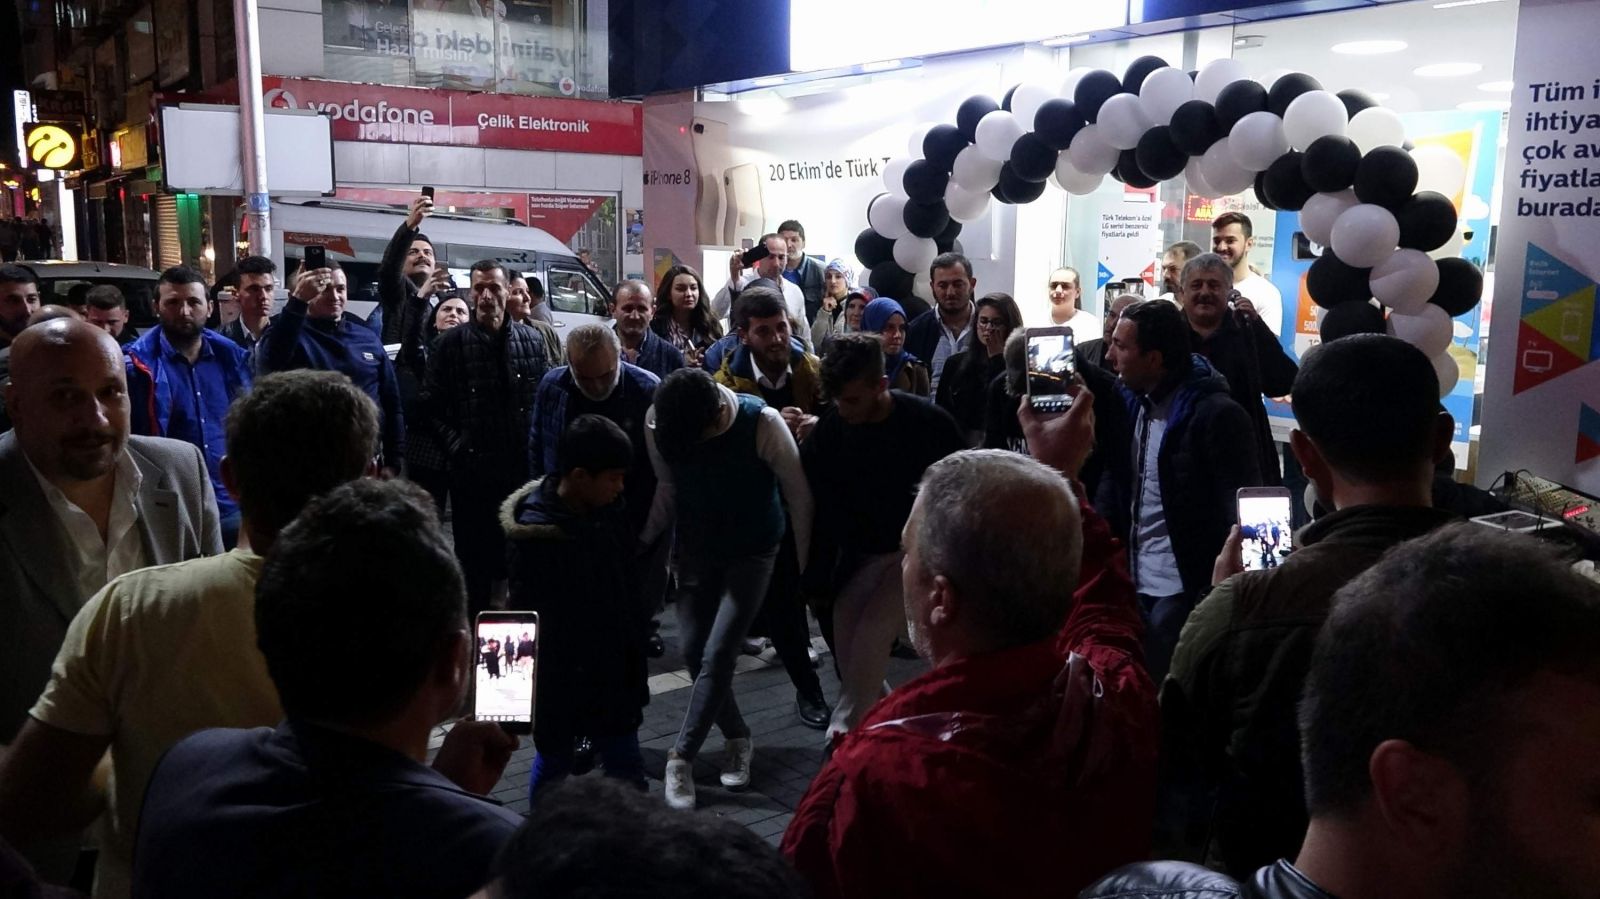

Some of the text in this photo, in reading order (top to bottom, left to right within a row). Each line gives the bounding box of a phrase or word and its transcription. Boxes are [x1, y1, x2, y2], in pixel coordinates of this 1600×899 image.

[1529, 83, 1585, 103] Tüm
[306, 100, 434, 126] vodafone
[478, 112, 590, 133] Çelik Elektronik
[1522, 140, 1566, 165] çok
[650, 169, 691, 186] iPhone 8
[769, 157, 879, 181] 20 Ekim'de Türk
